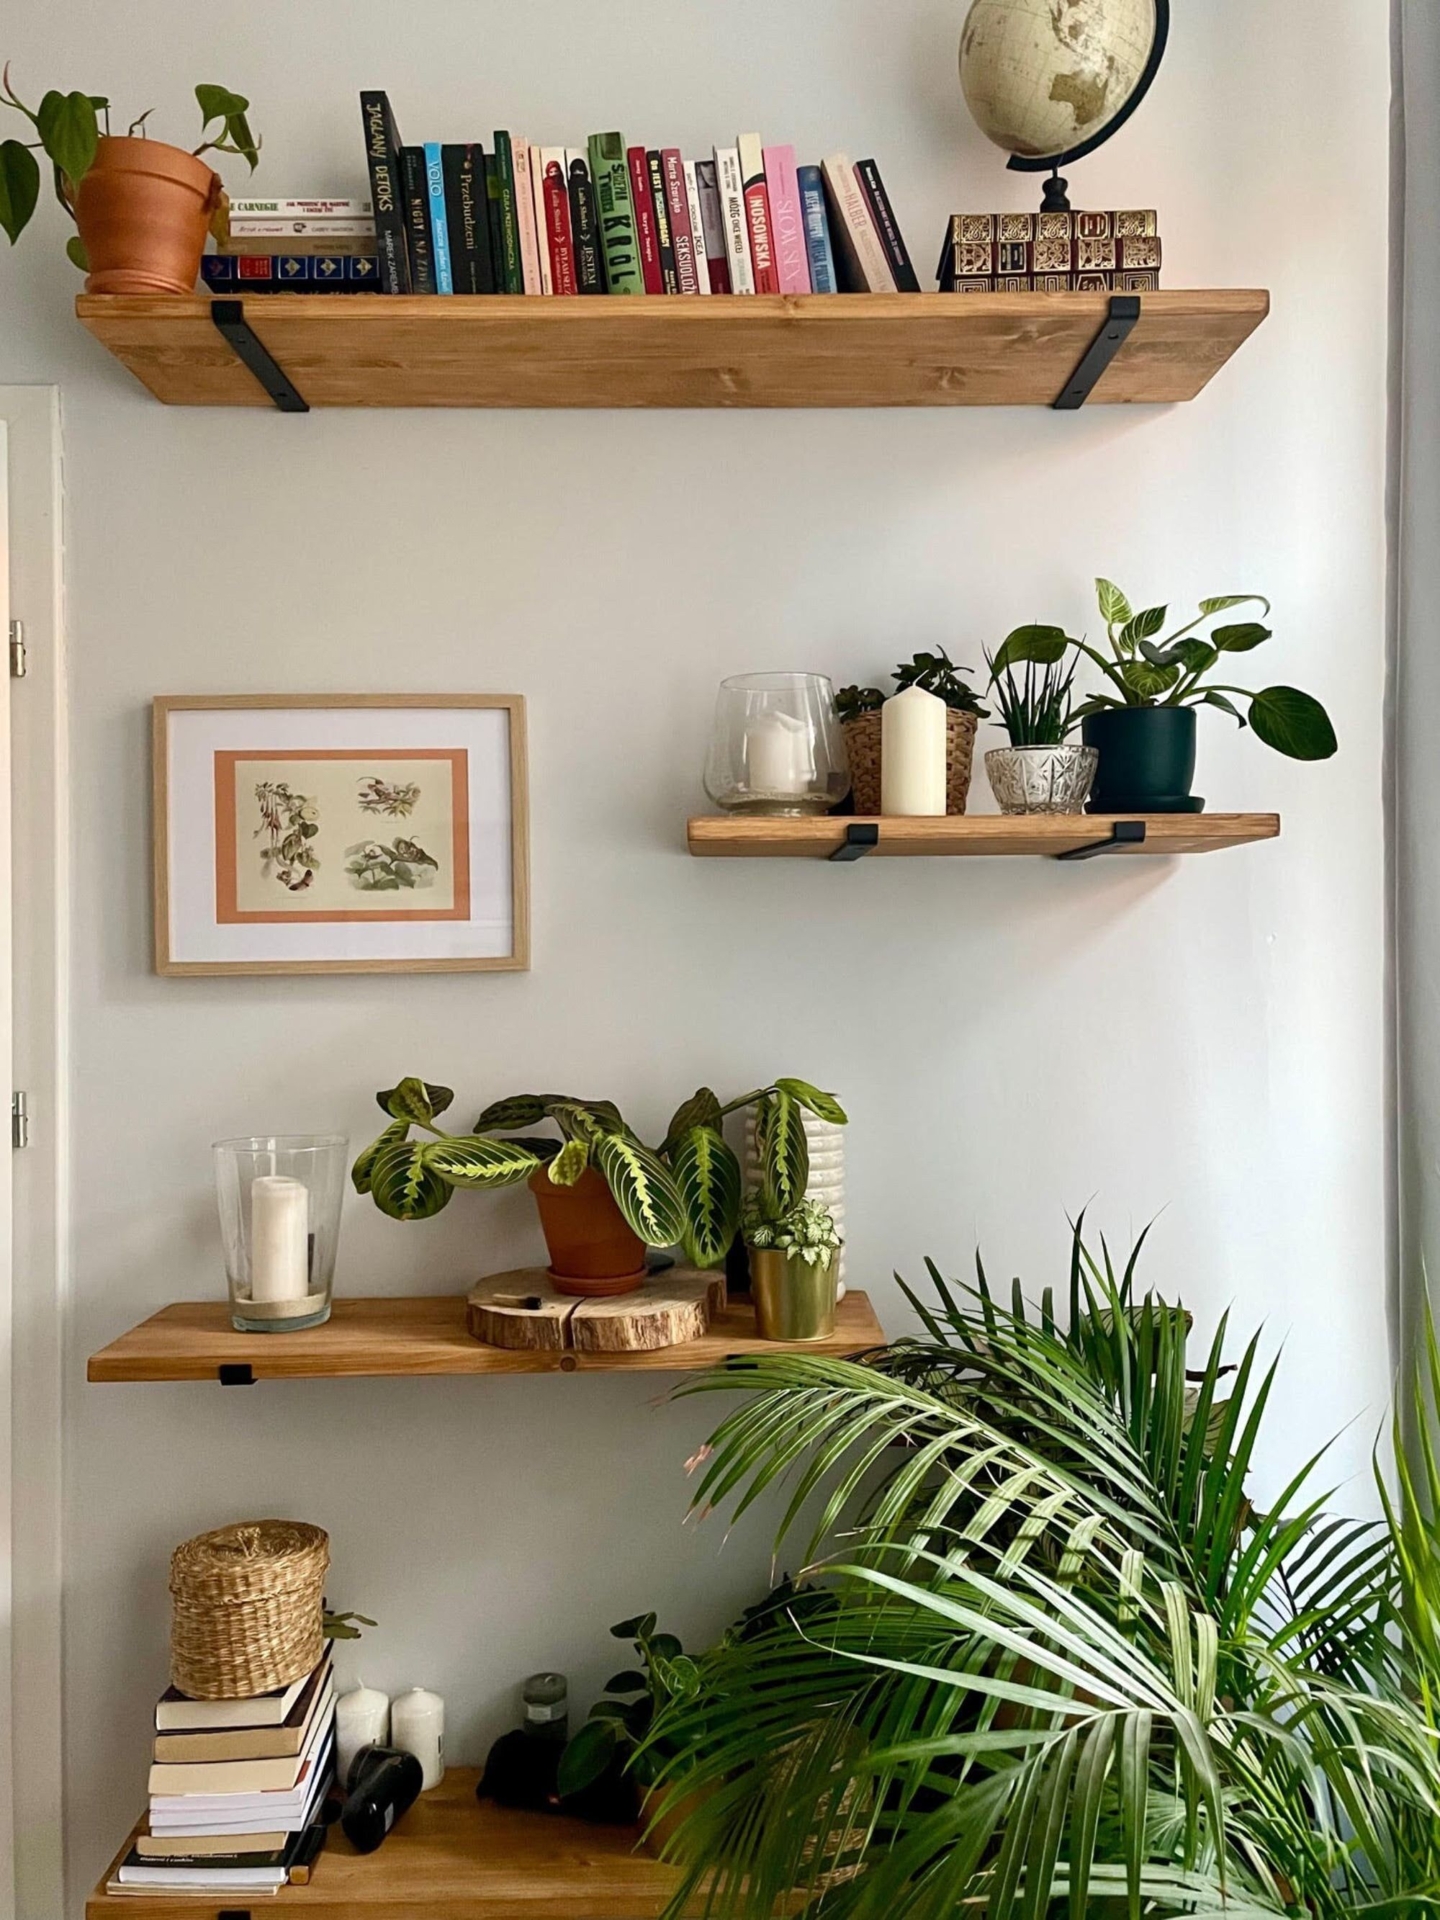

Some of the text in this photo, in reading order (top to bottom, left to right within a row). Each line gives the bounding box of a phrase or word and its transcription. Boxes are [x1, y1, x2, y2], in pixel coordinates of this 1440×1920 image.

[366, 103, 393, 211] JAGLANY DETOKS
[429, 161, 441, 196] VOLO
[652, 172, 661, 189] JEST
[667, 157, 683, 213] Marta Szarejko
[238, 203, 278, 211] CARNEGIE
[411, 199, 425, 230] NIGDY
[460, 174, 477, 250] Przebudzeni
[578, 187, 588, 230] Laila Shukri
[728, 197, 741, 218] MÓZG
[844, 193, 867, 229] HALBER
[384, 230, 394, 259] MAREK
[504, 213, 514, 270] PRZEWODNICZKA
[732, 219, 740, 233] CHCE
[750, 199, 771, 269] NOSOWSKA
[776, 200, 801, 281] SLOW SEX
[603, 214, 636, 285] KRÓL
[694, 235, 703, 256] IKEA
[583, 245, 596, 284] JESTEM
